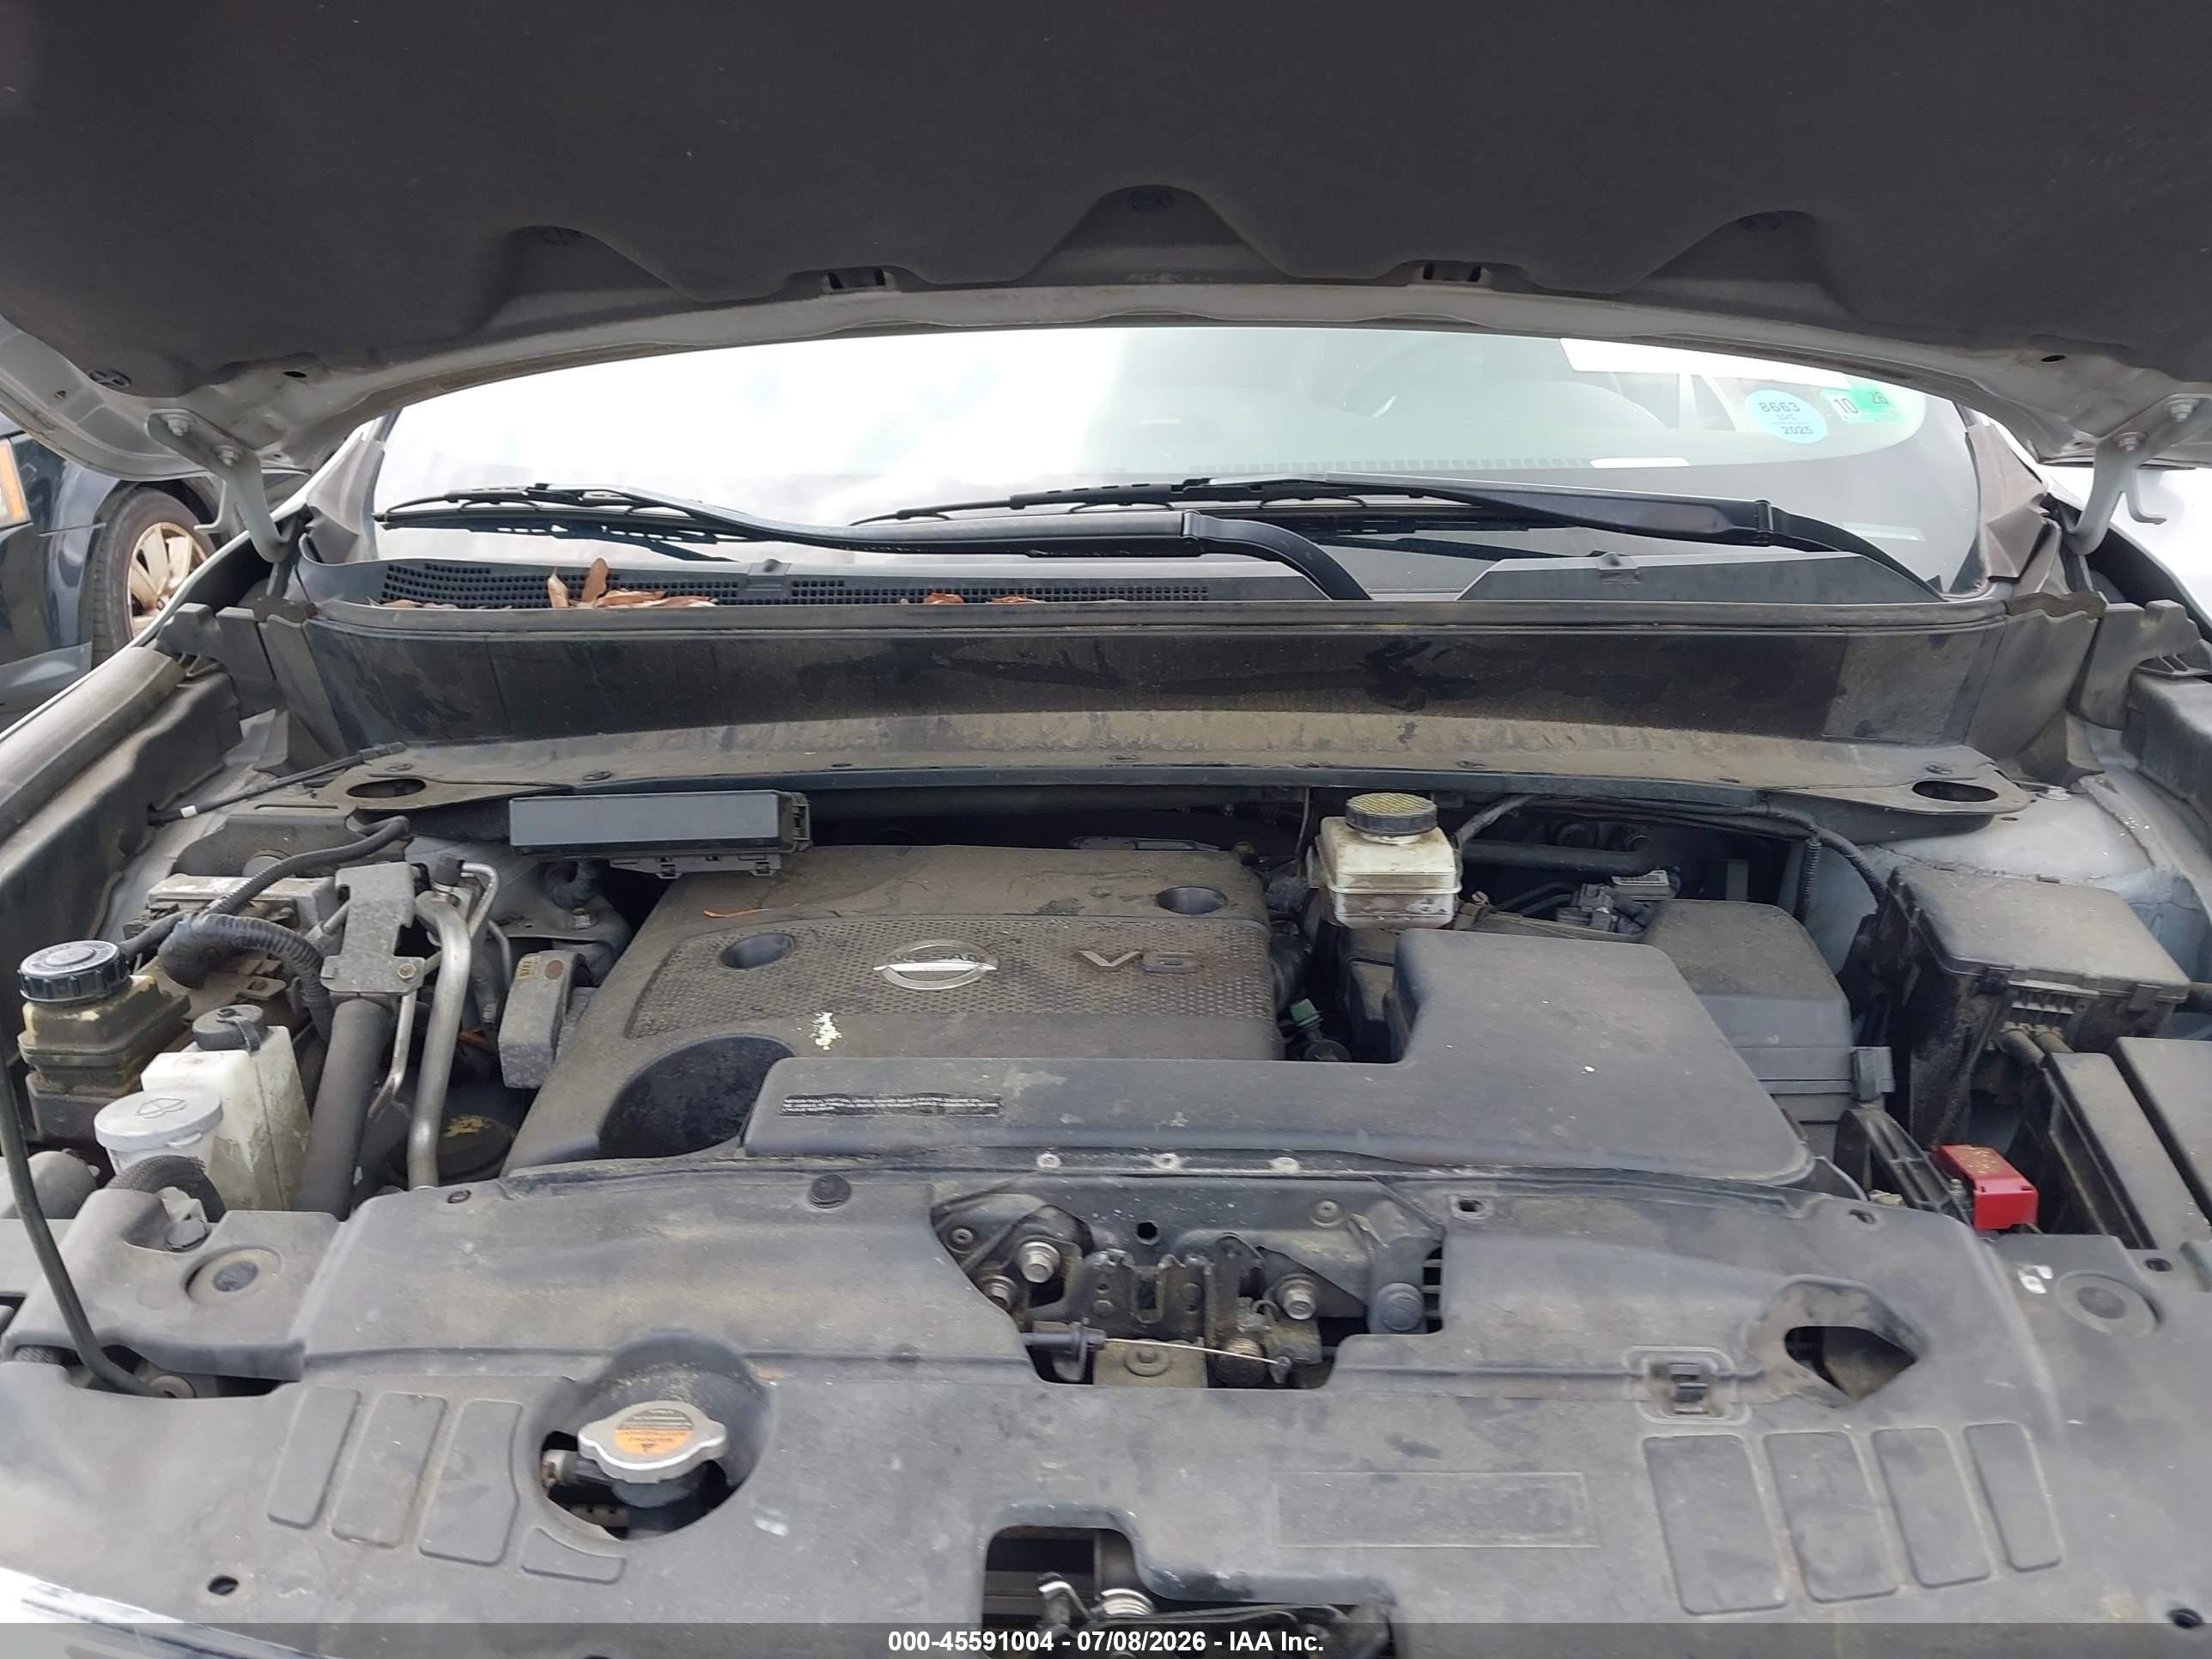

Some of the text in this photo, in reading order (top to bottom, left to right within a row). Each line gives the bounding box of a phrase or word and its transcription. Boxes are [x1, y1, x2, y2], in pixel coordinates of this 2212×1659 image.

[1759, 401, 1800, 412] 8663
[1832, 398, 1859, 414] 10
[1780, 426, 1814, 434] 2025
